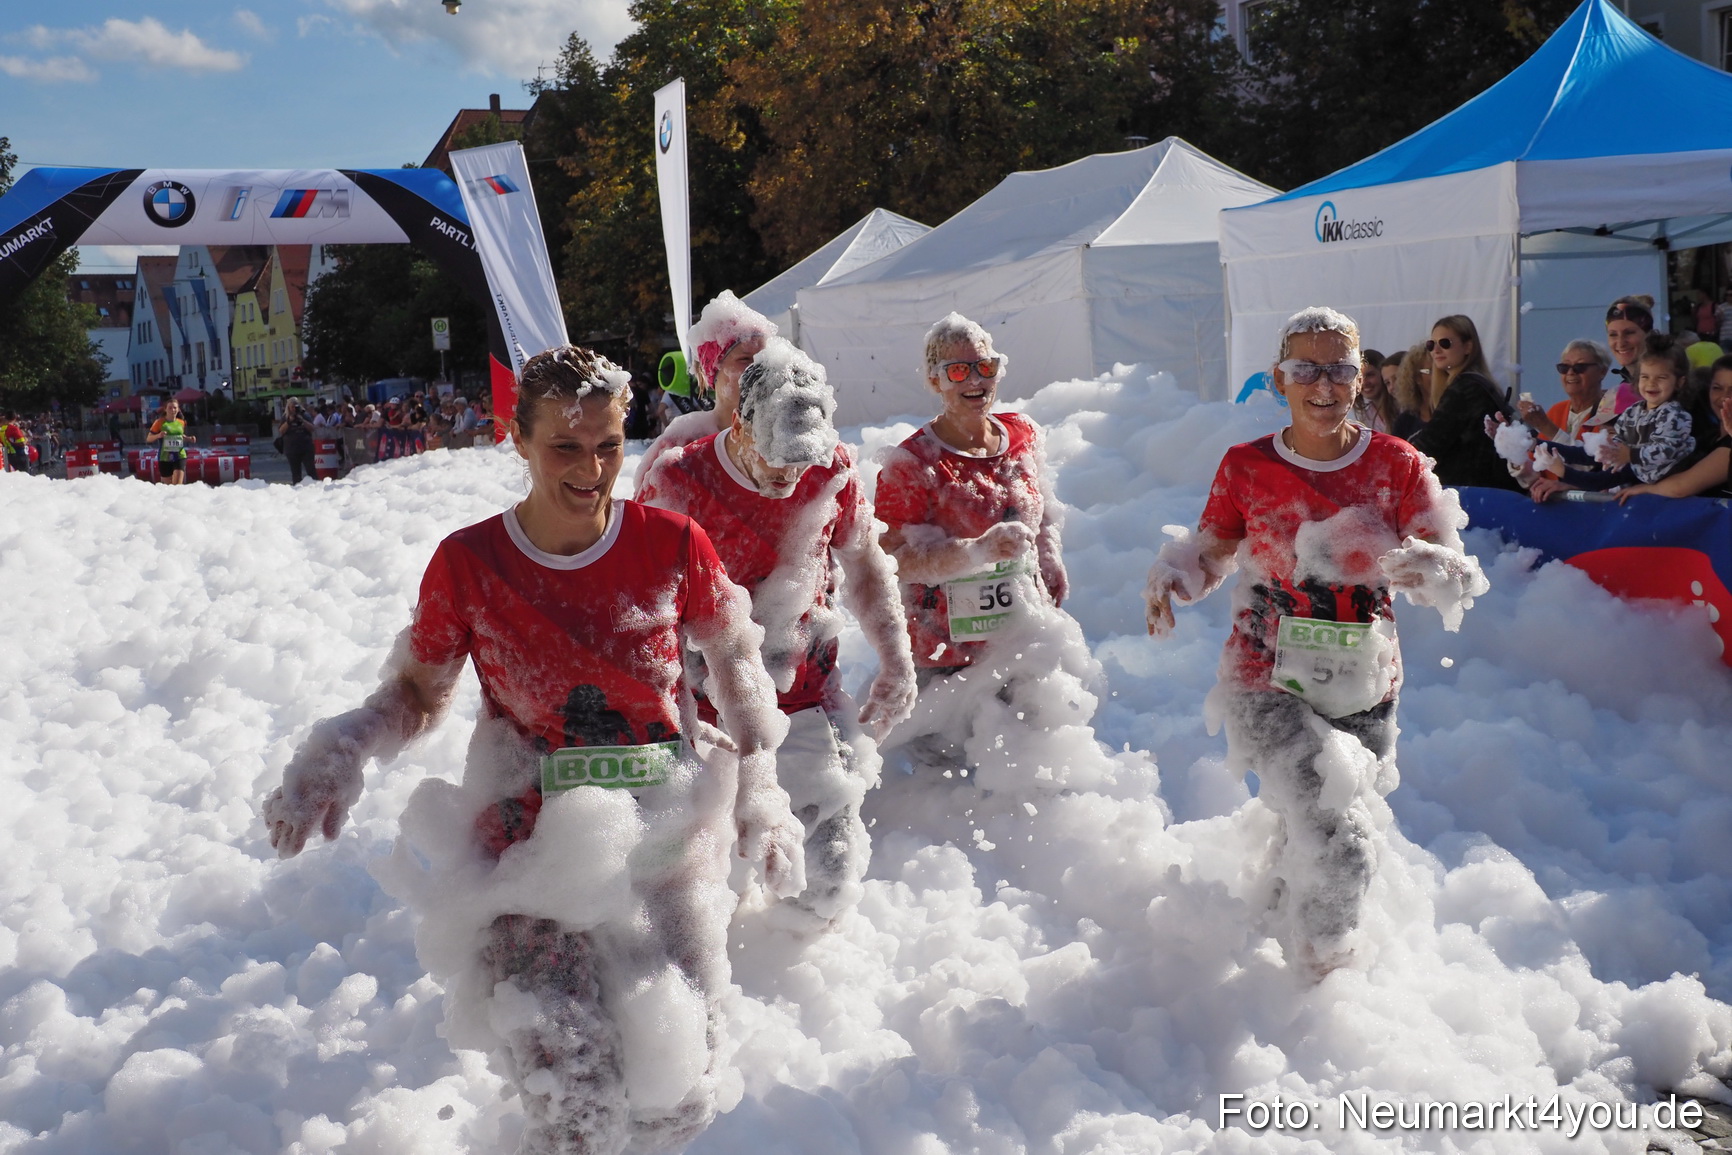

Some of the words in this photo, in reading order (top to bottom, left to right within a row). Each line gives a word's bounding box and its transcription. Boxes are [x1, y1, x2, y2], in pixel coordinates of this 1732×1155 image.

[430, 216, 469, 248] PARTL
[1344, 216, 1384, 241] classic
[78, 469, 94, 477] AVIA
[979, 582, 1013, 611] 56
[1290, 623, 1361, 648] BOC
[555, 755, 649, 783] BOC
